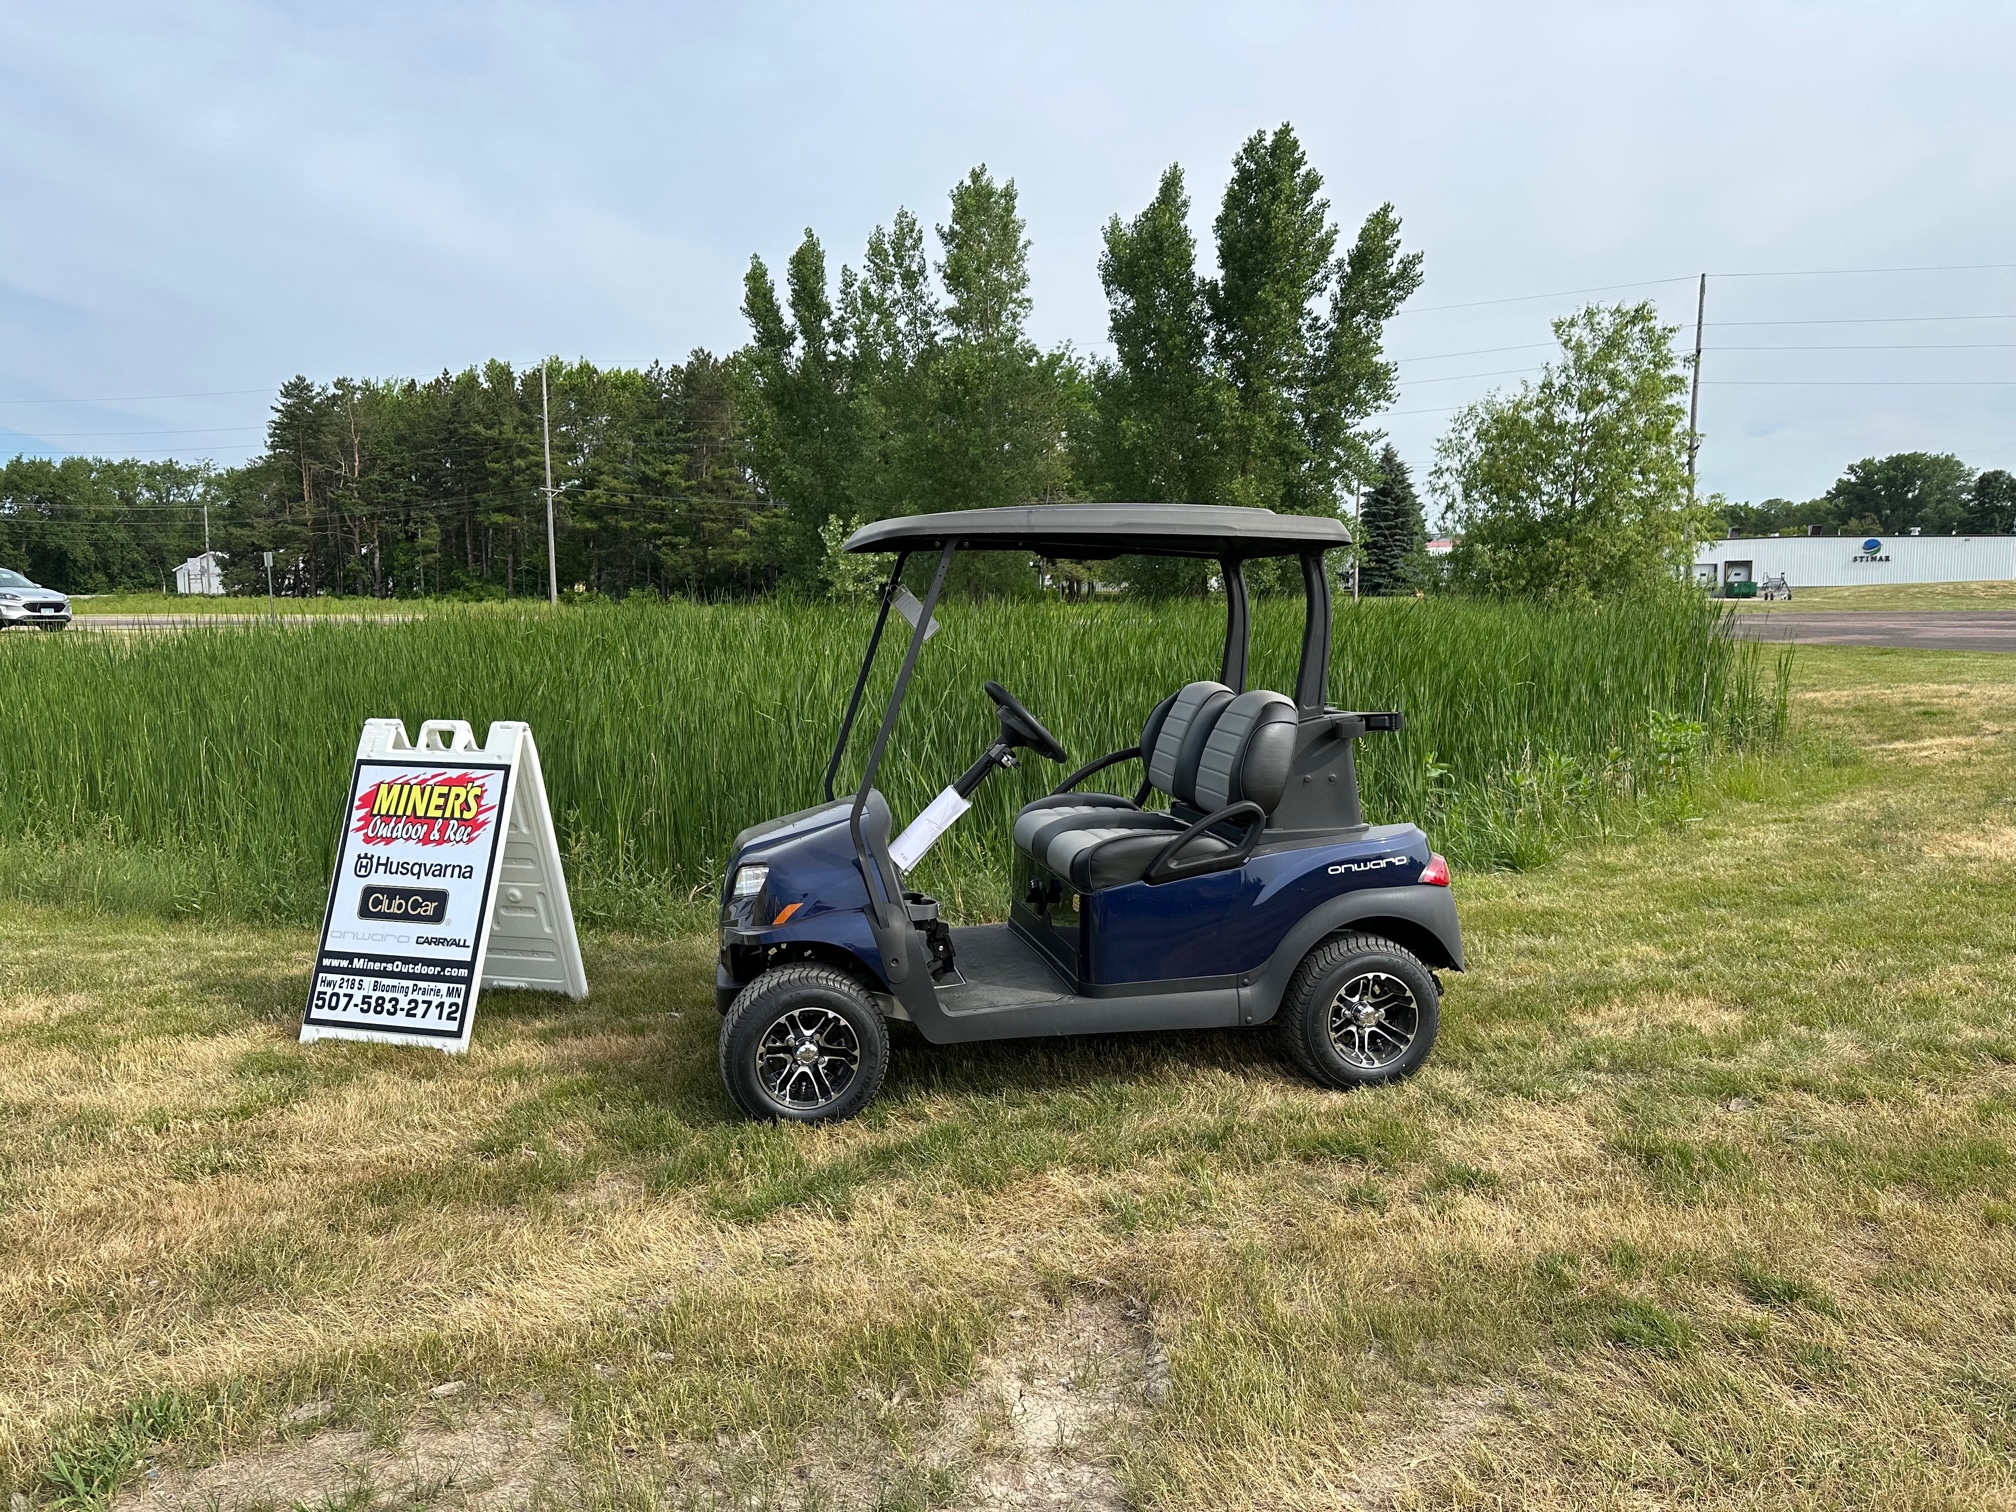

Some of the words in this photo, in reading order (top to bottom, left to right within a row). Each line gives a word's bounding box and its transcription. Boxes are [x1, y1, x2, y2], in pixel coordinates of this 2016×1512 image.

[371, 782, 483, 820] MINER'S
[367, 815, 428, 840] Outdoor
[429, 823, 441, 841] &
[443, 819, 473, 843] Rec
[374, 856, 474, 880] Husqvarna
[368, 893, 406, 914] Club
[407, 896, 438, 916] Car
[415, 935, 471, 948] CARRYALL
[322, 957, 469, 977] www.MinersOutdoor.com
[319, 976, 338, 989] Hwy
[338, 977, 355, 991] 218
[372, 980, 410, 997] Blooming
[411, 983, 443, 999] Prairie,
[446, 986, 462, 999] MN
[314, 991, 461, 1022] 507-583-2712
